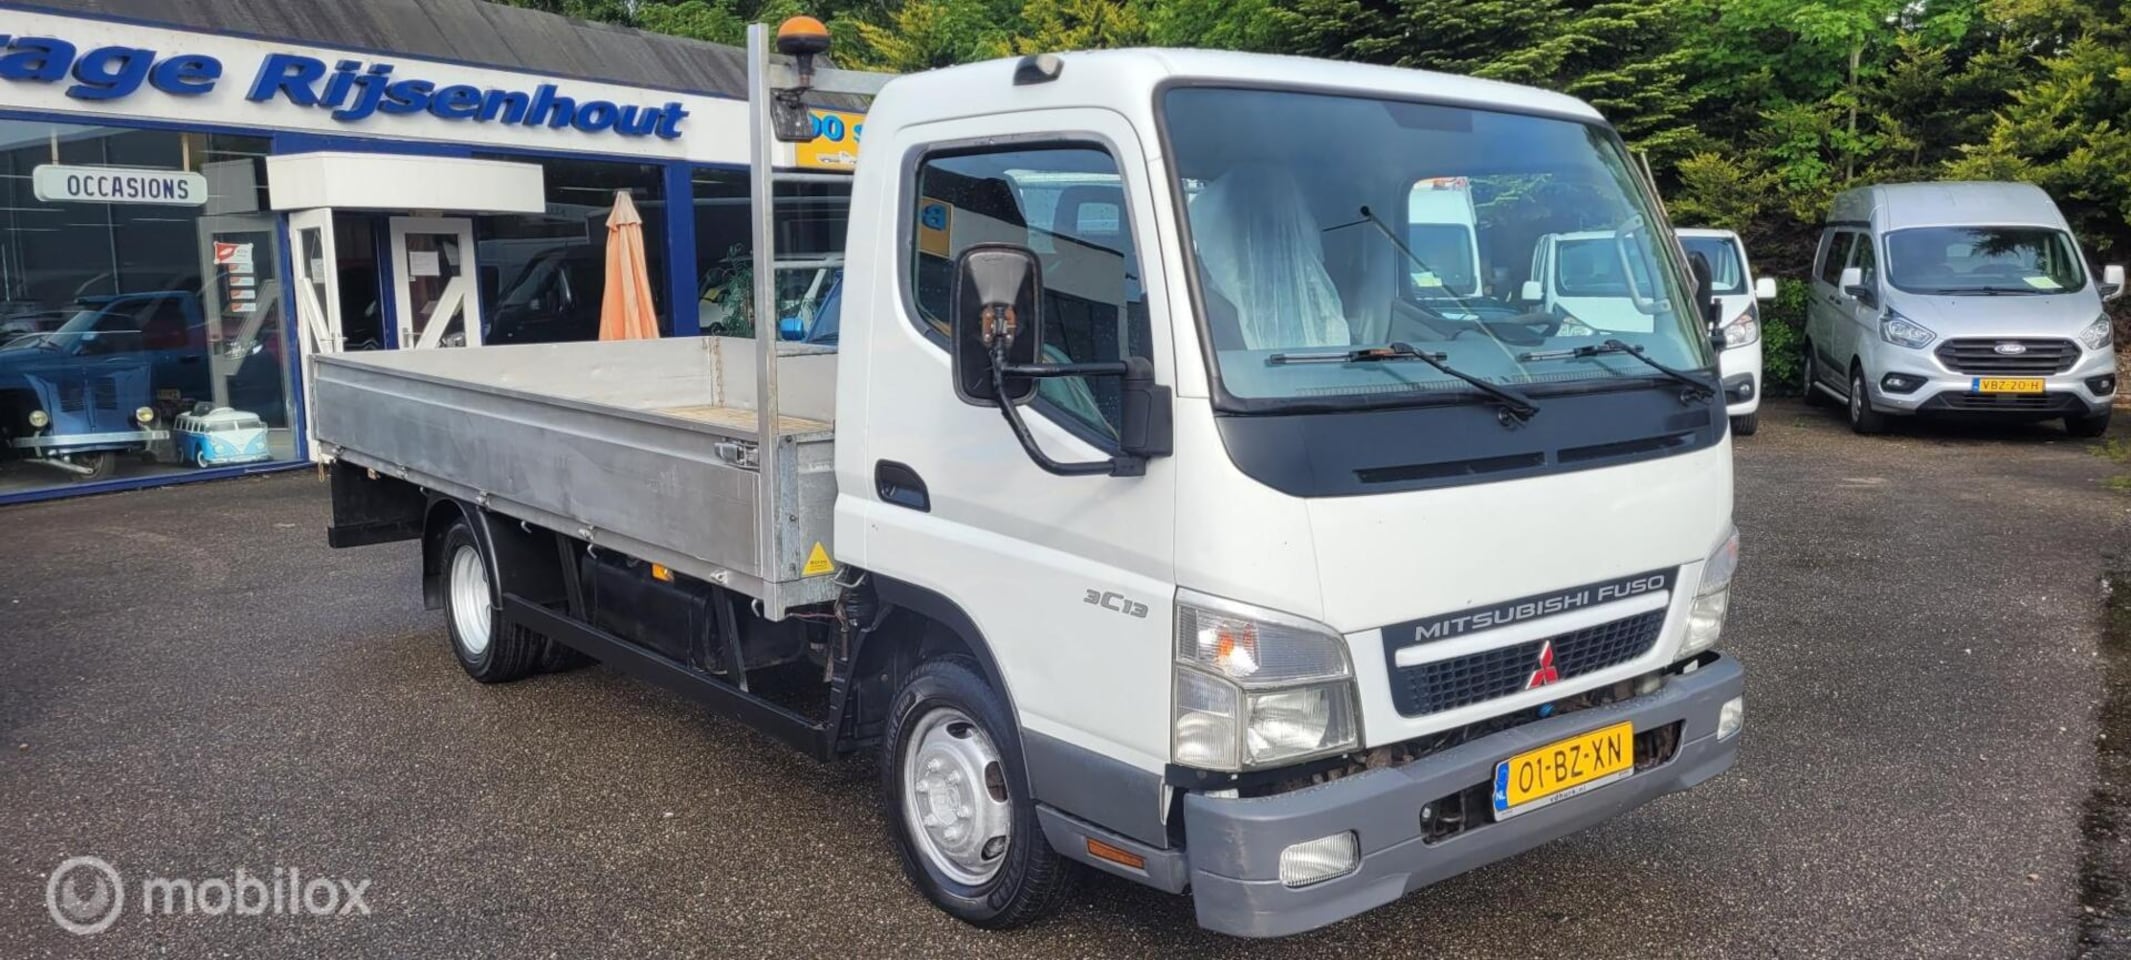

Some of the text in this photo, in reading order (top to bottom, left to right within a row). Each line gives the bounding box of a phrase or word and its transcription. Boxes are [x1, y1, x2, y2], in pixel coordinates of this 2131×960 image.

[0, 34, 690, 140] age Rijsenhout
[67, 174, 189, 200] OCCASIONS
[1083, 588, 1149, 618] 3C13
[1415, 574, 1666, 642] MITSUBISHI FUSO
[1518, 733, 1622, 794] 01-BZ-XN
